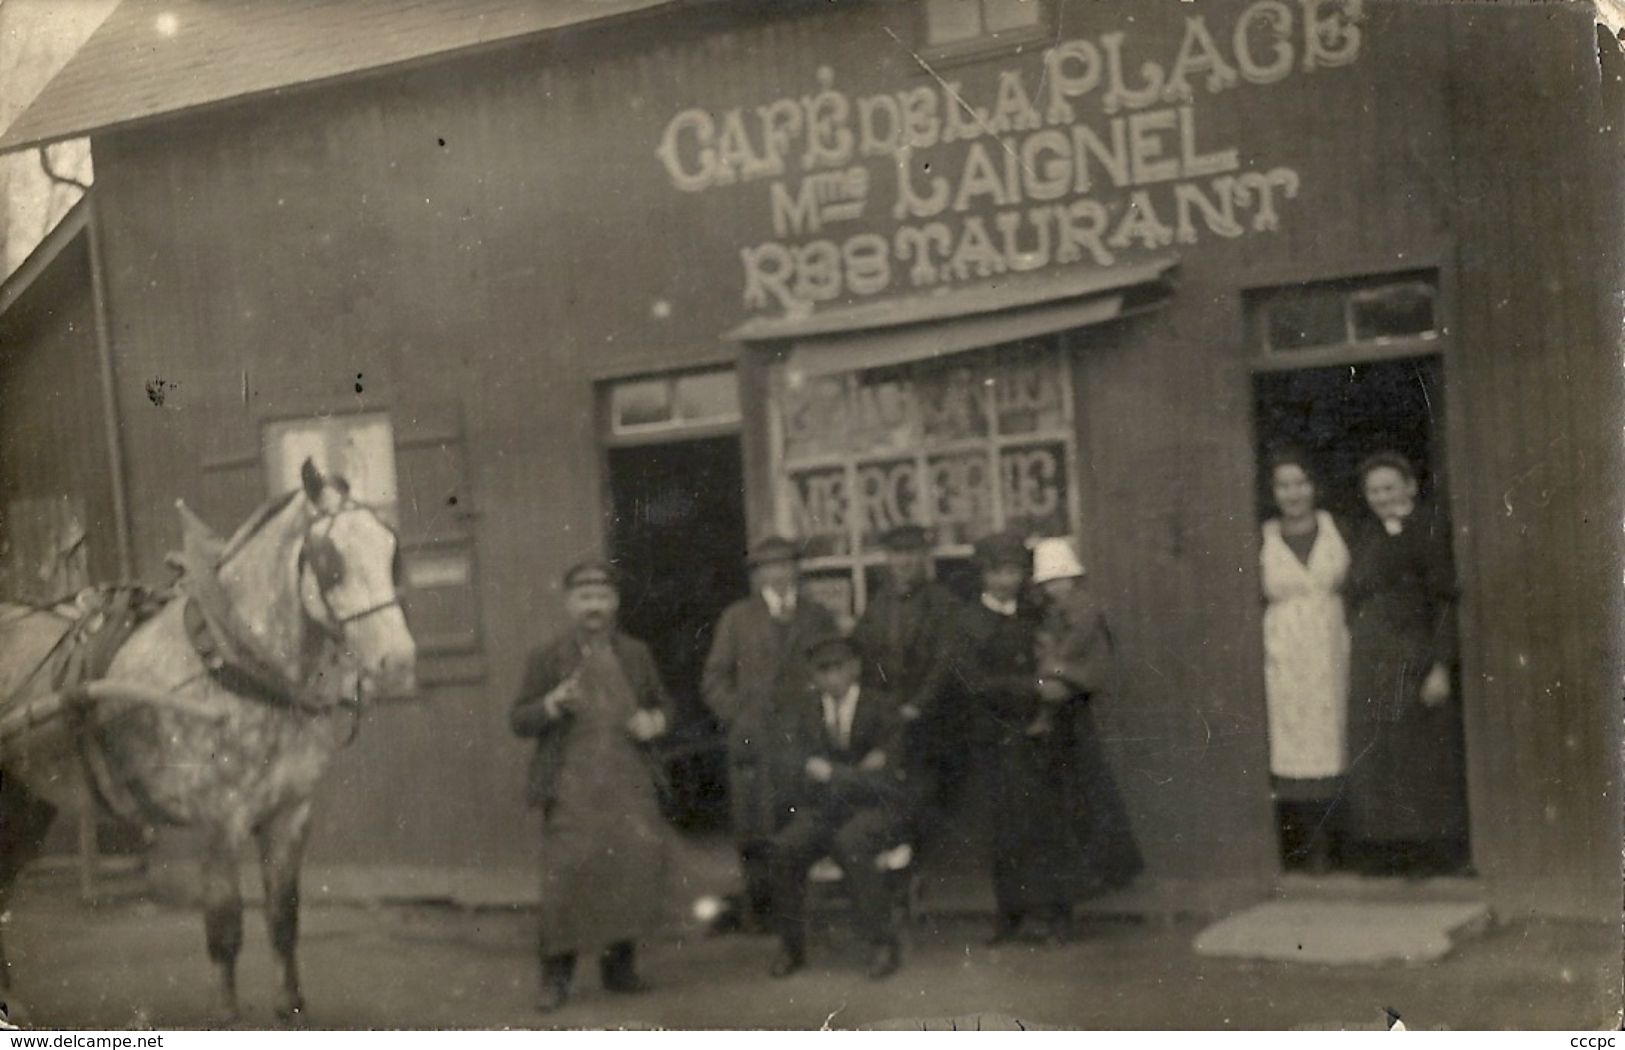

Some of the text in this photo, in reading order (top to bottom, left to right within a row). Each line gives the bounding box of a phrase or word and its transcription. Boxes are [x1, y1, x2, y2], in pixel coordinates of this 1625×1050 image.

[657, 0, 1364, 191] CAFÉ DE LA PLACE
[893, 106, 1239, 218] LAIGNEL
[741, 168, 1300, 314] RESTAURANT
[785, 449, 1058, 533] MERCERIE
